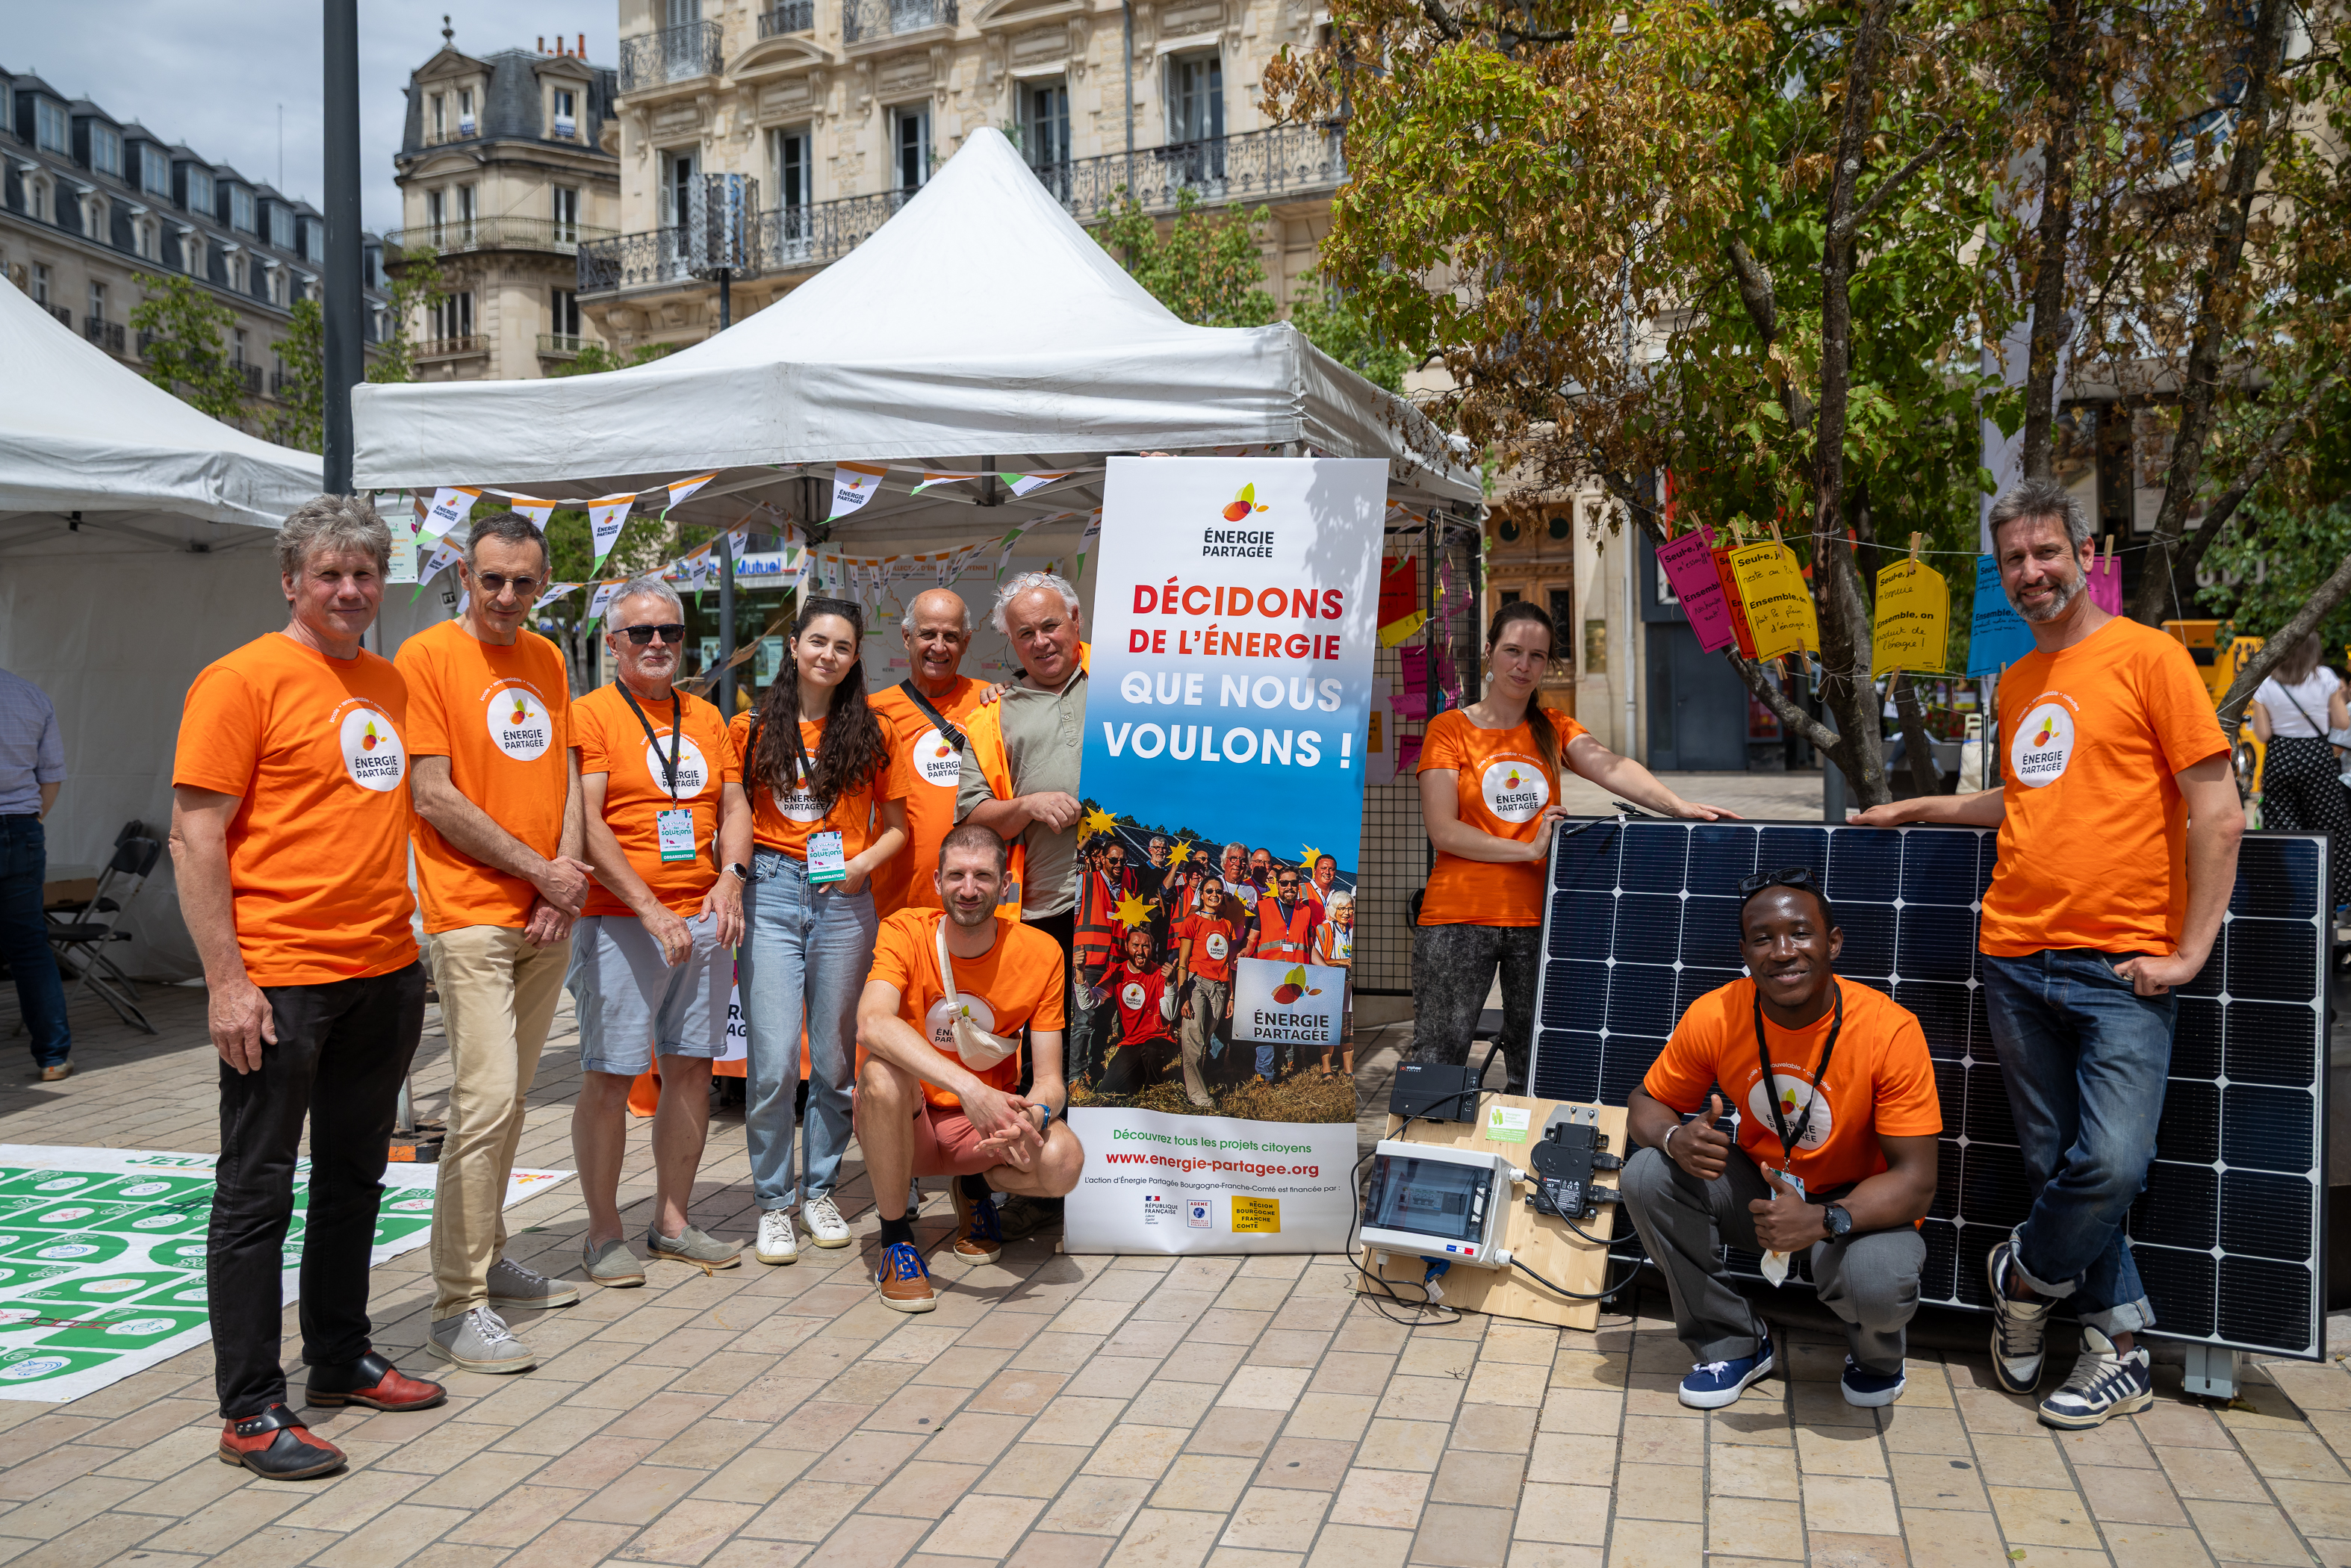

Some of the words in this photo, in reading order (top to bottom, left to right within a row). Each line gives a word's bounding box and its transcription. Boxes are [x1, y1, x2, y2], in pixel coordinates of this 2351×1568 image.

[837, 495, 863, 505] PARTAGÉE
[839, 489, 865, 501] ÉNERGIE
[432, 509, 456, 522] PARTAGÉE
[435, 505, 459, 517] ÉNERGIE
[597, 524, 619, 533] ÉNERGIE
[597, 529, 618, 538] PARTAGÉE
[1203, 528, 1274, 545] ÉNERGIE
[1202, 545, 1273, 558] PARTAGÉE
[1695, 541, 1704, 551] je
[736, 558, 781, 575] Mutuel
[1132, 576, 1344, 620] DÉCIDONS
[1683, 581, 1721, 603] Ensembl
[1750, 593, 1799, 609] Ensemble,
[1799, 597, 1807, 605] on
[1877, 611, 1918, 629] Ensemble,
[1975, 609, 2014, 621] Ensemble,
[1912, 626, 1926, 635] de
[1128, 629, 1167, 654] DE
[1120, 671, 1204, 706] QUE
[1220, 674, 1342, 712] NOUS
[503, 729, 543, 741] ÉNERGIE
[680, 732, 699, 747] collective
[505, 738, 544, 750] PARTAGÉE
[1102, 721, 1322, 768] VOULONS
[1340, 732, 1352, 769] !
[355, 756, 397, 769] ÉNERGIE
[1477, 759, 1486, 769] ocale
[1489, 751, 1518, 759] renouvelable
[1522, 754, 1543, 766] collective
[2022, 750, 2063, 765] ÉNERGIE
[356, 765, 399, 779] PARTAGÉE
[927, 761, 960, 771] ÉNERGI
[2021, 762, 2061, 775] PARTAGÉE
[661, 770, 699, 780] ÉERGIE
[928, 769, 960, 778] PARTAG
[662, 778, 701, 788] PATAGÉE
[1496, 792, 1538, 804] ÉNERGIE
[1497, 801, 1538, 812] PARTAGÉE
[661, 828, 692, 836] solutions
[810, 850, 842, 858] solutions
[1254, 1009, 1329, 1028] ÉNERGIE
[1254, 1027, 1329, 1042] PARTAGÉE
[1770, 1062, 1801, 1071] nouvelable
[1807, 1071, 1831, 1092] coctive
[1114, 1128, 1172, 1145] Découvrez
[1174, 1136, 1198, 1146] tous
[1201, 1137, 1217, 1148] les
[1220, 1139, 1258, 1151] projets
[1261, 1142, 1311, 1154] citoyens
[125, 1156, 210, 1166] JEU
[1106, 1154, 1319, 1178] www.energie-partagee.org
[1149, 1177, 1178, 1187] Partagée
[1181, 1181, 1276, 1192] Bourgogne-Franche-Comté
[1145, 1202, 1178, 1210] RÉPUBLIQUE
